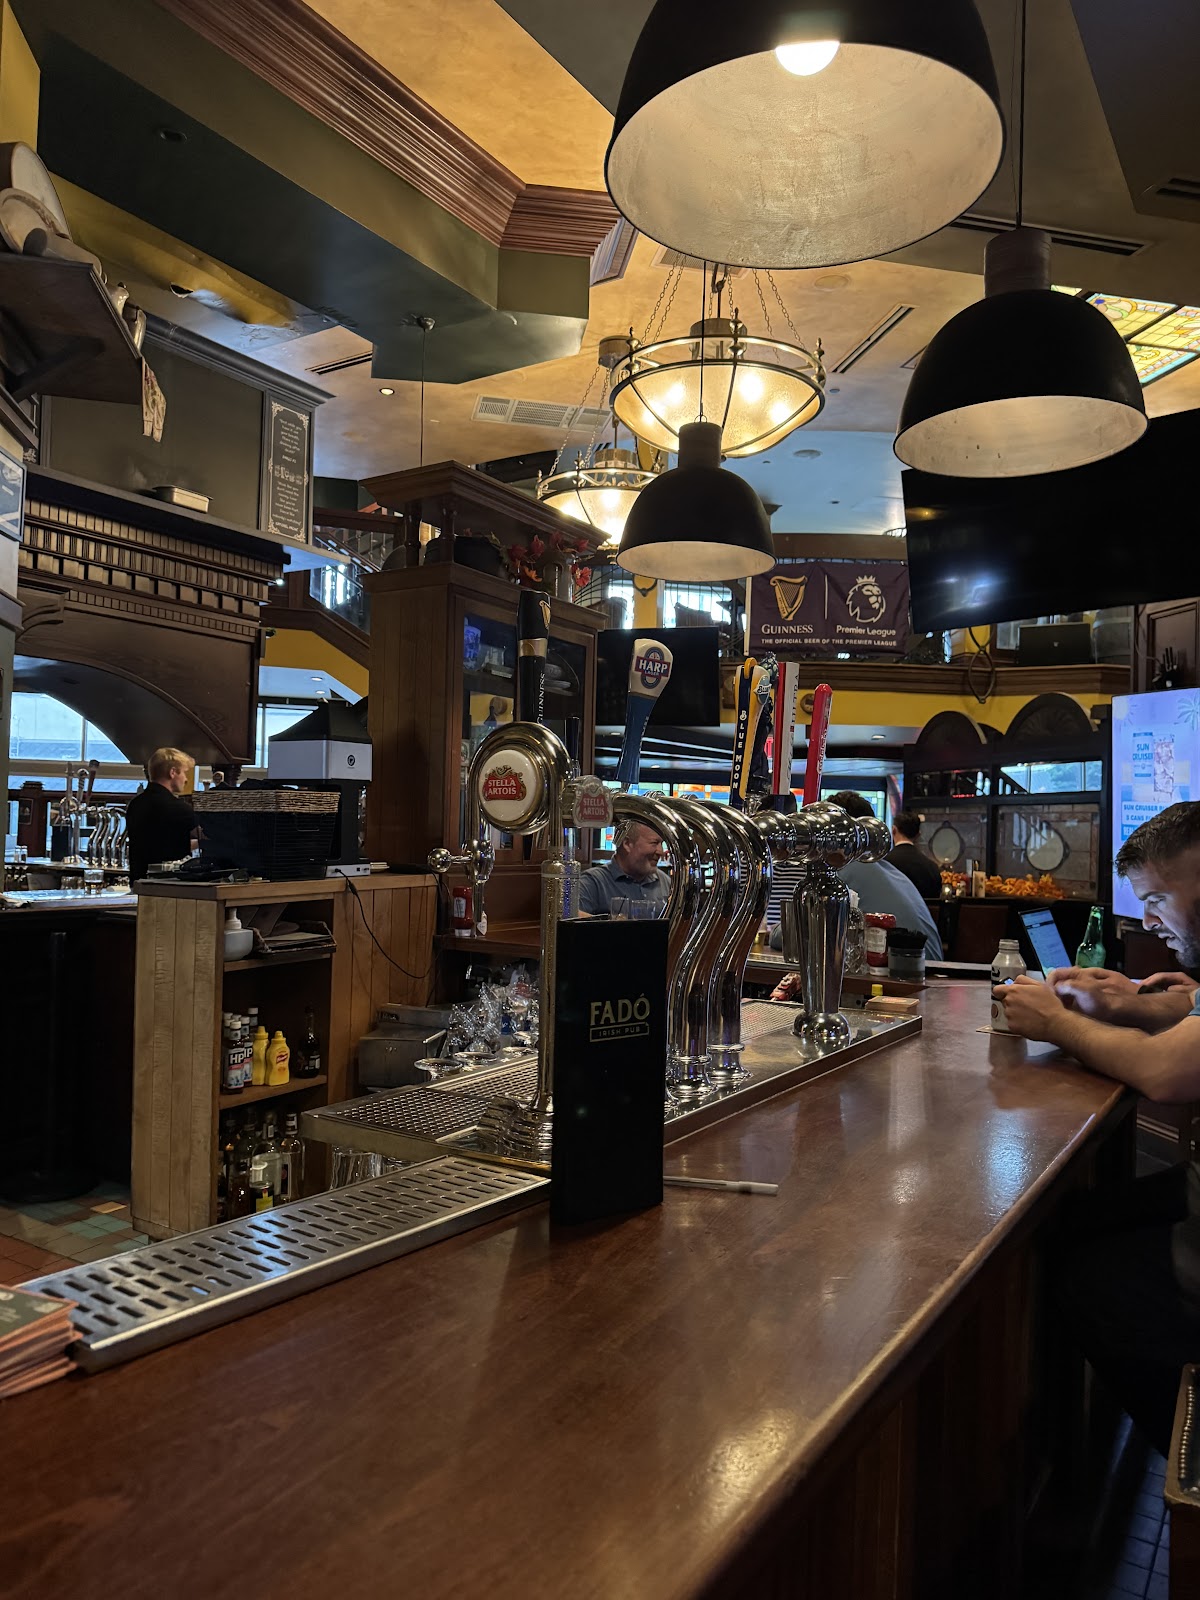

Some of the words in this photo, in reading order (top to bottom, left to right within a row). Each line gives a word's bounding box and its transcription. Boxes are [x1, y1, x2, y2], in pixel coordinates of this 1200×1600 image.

[761, 624, 814, 635] GUINNESS
[836, 624, 866, 635] Premier
[866, 627, 897, 638] League
[638, 659, 668, 674] HARP
[738, 709, 747, 749] BLUE
[1132, 752, 1153, 760] CRUISER
[732, 754, 742, 789] MOON
[488, 779, 517, 787] STELLA
[488, 787, 517, 795] ARTOIS
[583, 798, 605, 806] STELLA
[583, 807, 605, 816] ARTOIS
[590, 992, 651, 1026] FADÓ
[599, 1029, 621, 1037] IRISH
[624, 1026, 640, 1034] PUB
[229, 1053, 245, 1065] HP
